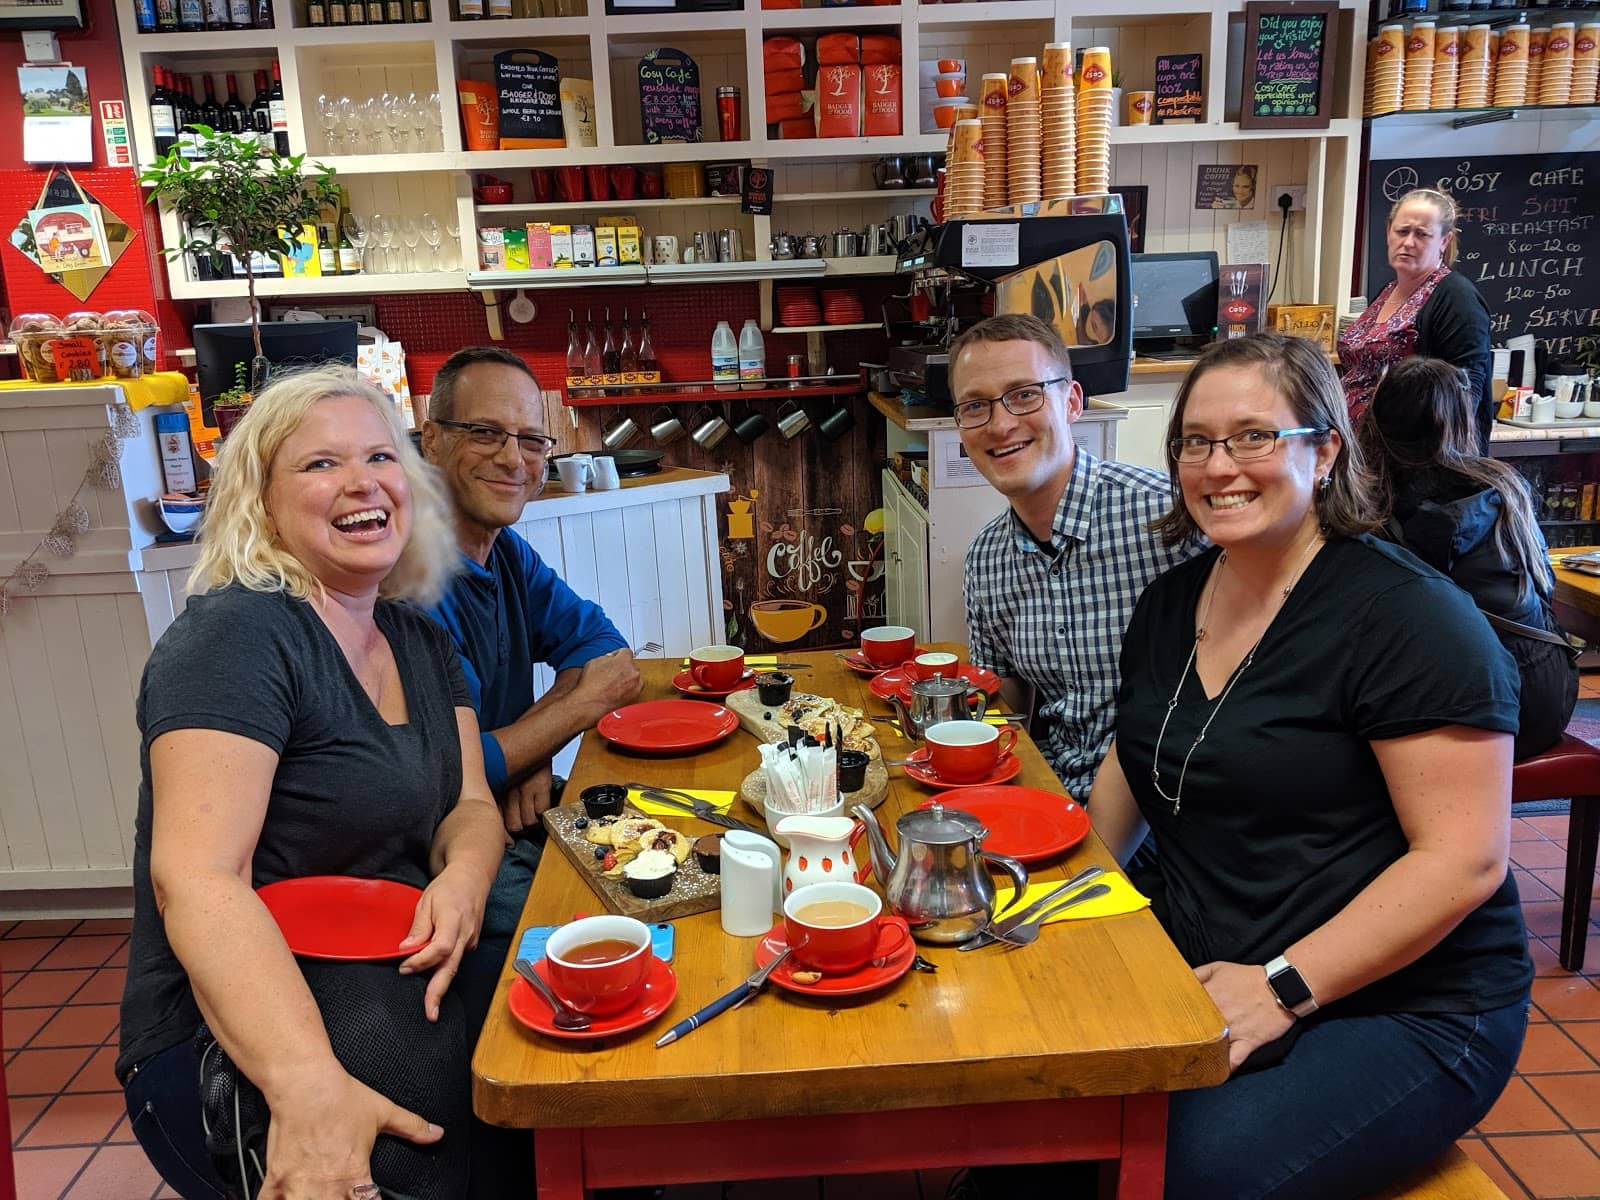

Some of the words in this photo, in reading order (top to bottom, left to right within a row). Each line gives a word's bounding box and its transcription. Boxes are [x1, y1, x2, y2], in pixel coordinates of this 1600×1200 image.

[1260, 15, 1280, 29] Did
[1282, 19, 1298, 38] you
[1300, 16, 1324, 38] enjoy
[1257, 32, 1278, 46] your
[1256, 48, 1273, 60] Let
[1276, 51, 1287, 60] us
[1287, 47, 1312, 60] know
[1158, 59, 1170, 71] All
[1171, 62, 1187, 70] our
[1257, 62, 1267, 76] by
[1309, 61, 1320, 71] on
[640, 65, 664, 86] Cosy
[1157, 73, 1176, 84] cups
[500, 89, 533, 99] BADGER
[642, 83, 682, 92] reusable
[1158, 83, 1182, 94] 100%
[1254, 92, 1295, 103] appreciates
[1436, 171, 1502, 193] COSY
[1529, 167, 1585, 187] CAFE
[1521, 197, 1578, 217] SAT
[1483, 215, 1594, 236] BREAKFAST
[1475, 256, 1585, 282] LUNCH
[1228, 305, 1248, 313] COSY
